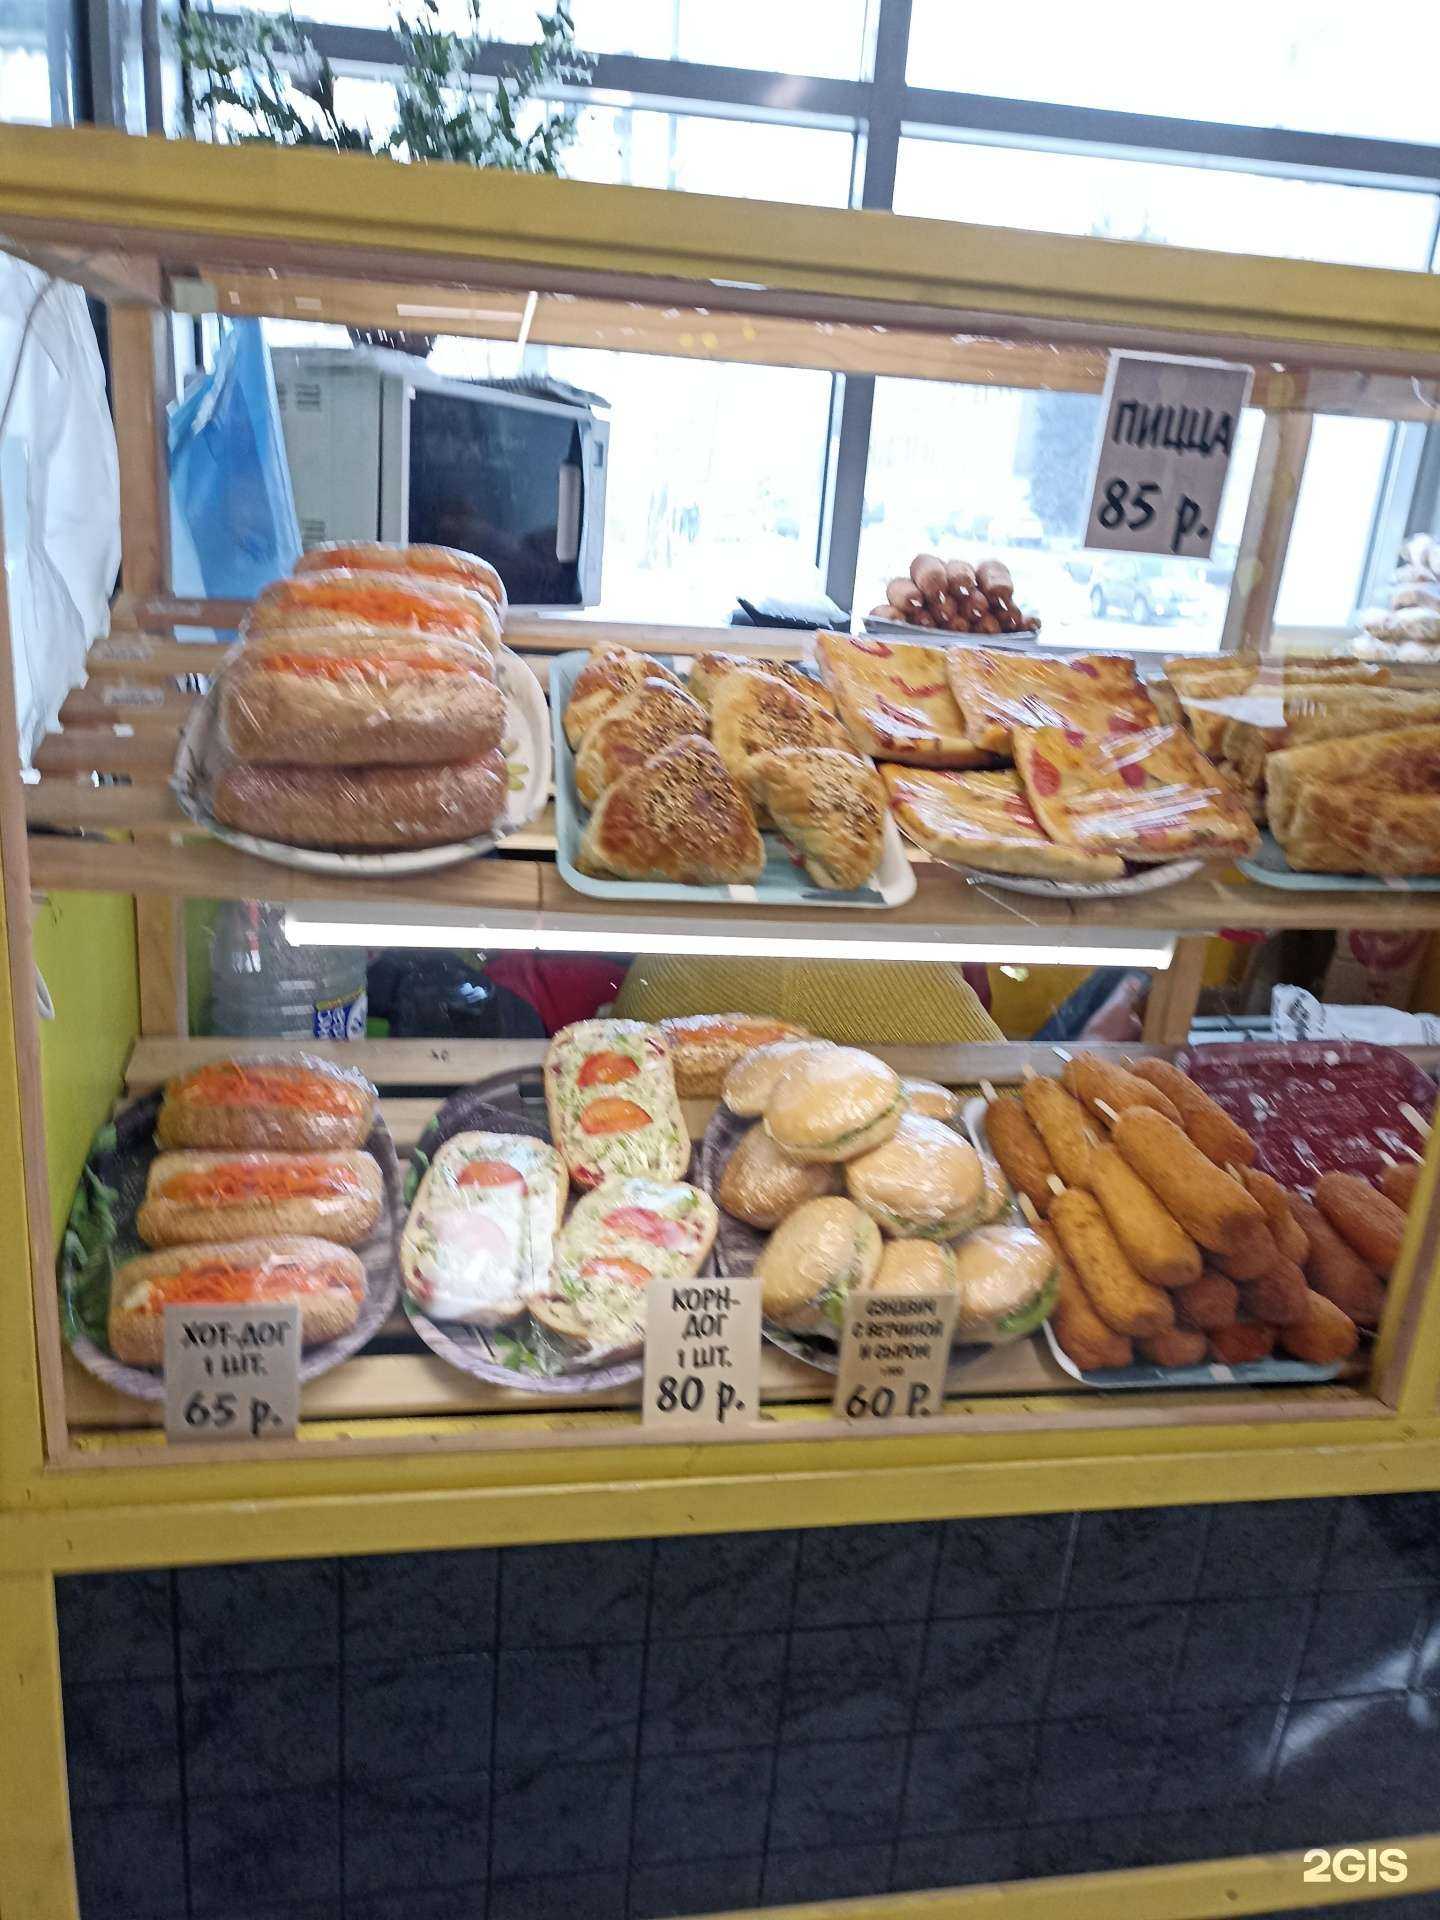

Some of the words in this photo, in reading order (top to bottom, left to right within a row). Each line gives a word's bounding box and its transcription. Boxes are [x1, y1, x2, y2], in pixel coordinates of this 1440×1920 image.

[1112, 400, 1231, 457] ПИЦЦА
[1099, 478, 1162, 531] 85
[672, 1287, 741, 1311] КОРН-
[180, 1321, 291, 1350] ХОТ-ДОГ
[682, 1314, 728, 1340] ДОГ
[204, 1356, 214, 1377] 1
[677, 1349, 685, 1368] 1
[656, 1375, 704, 1412] 80
[845, 1384, 896, 1418] 60
[184, 1391, 237, 1428] 65
